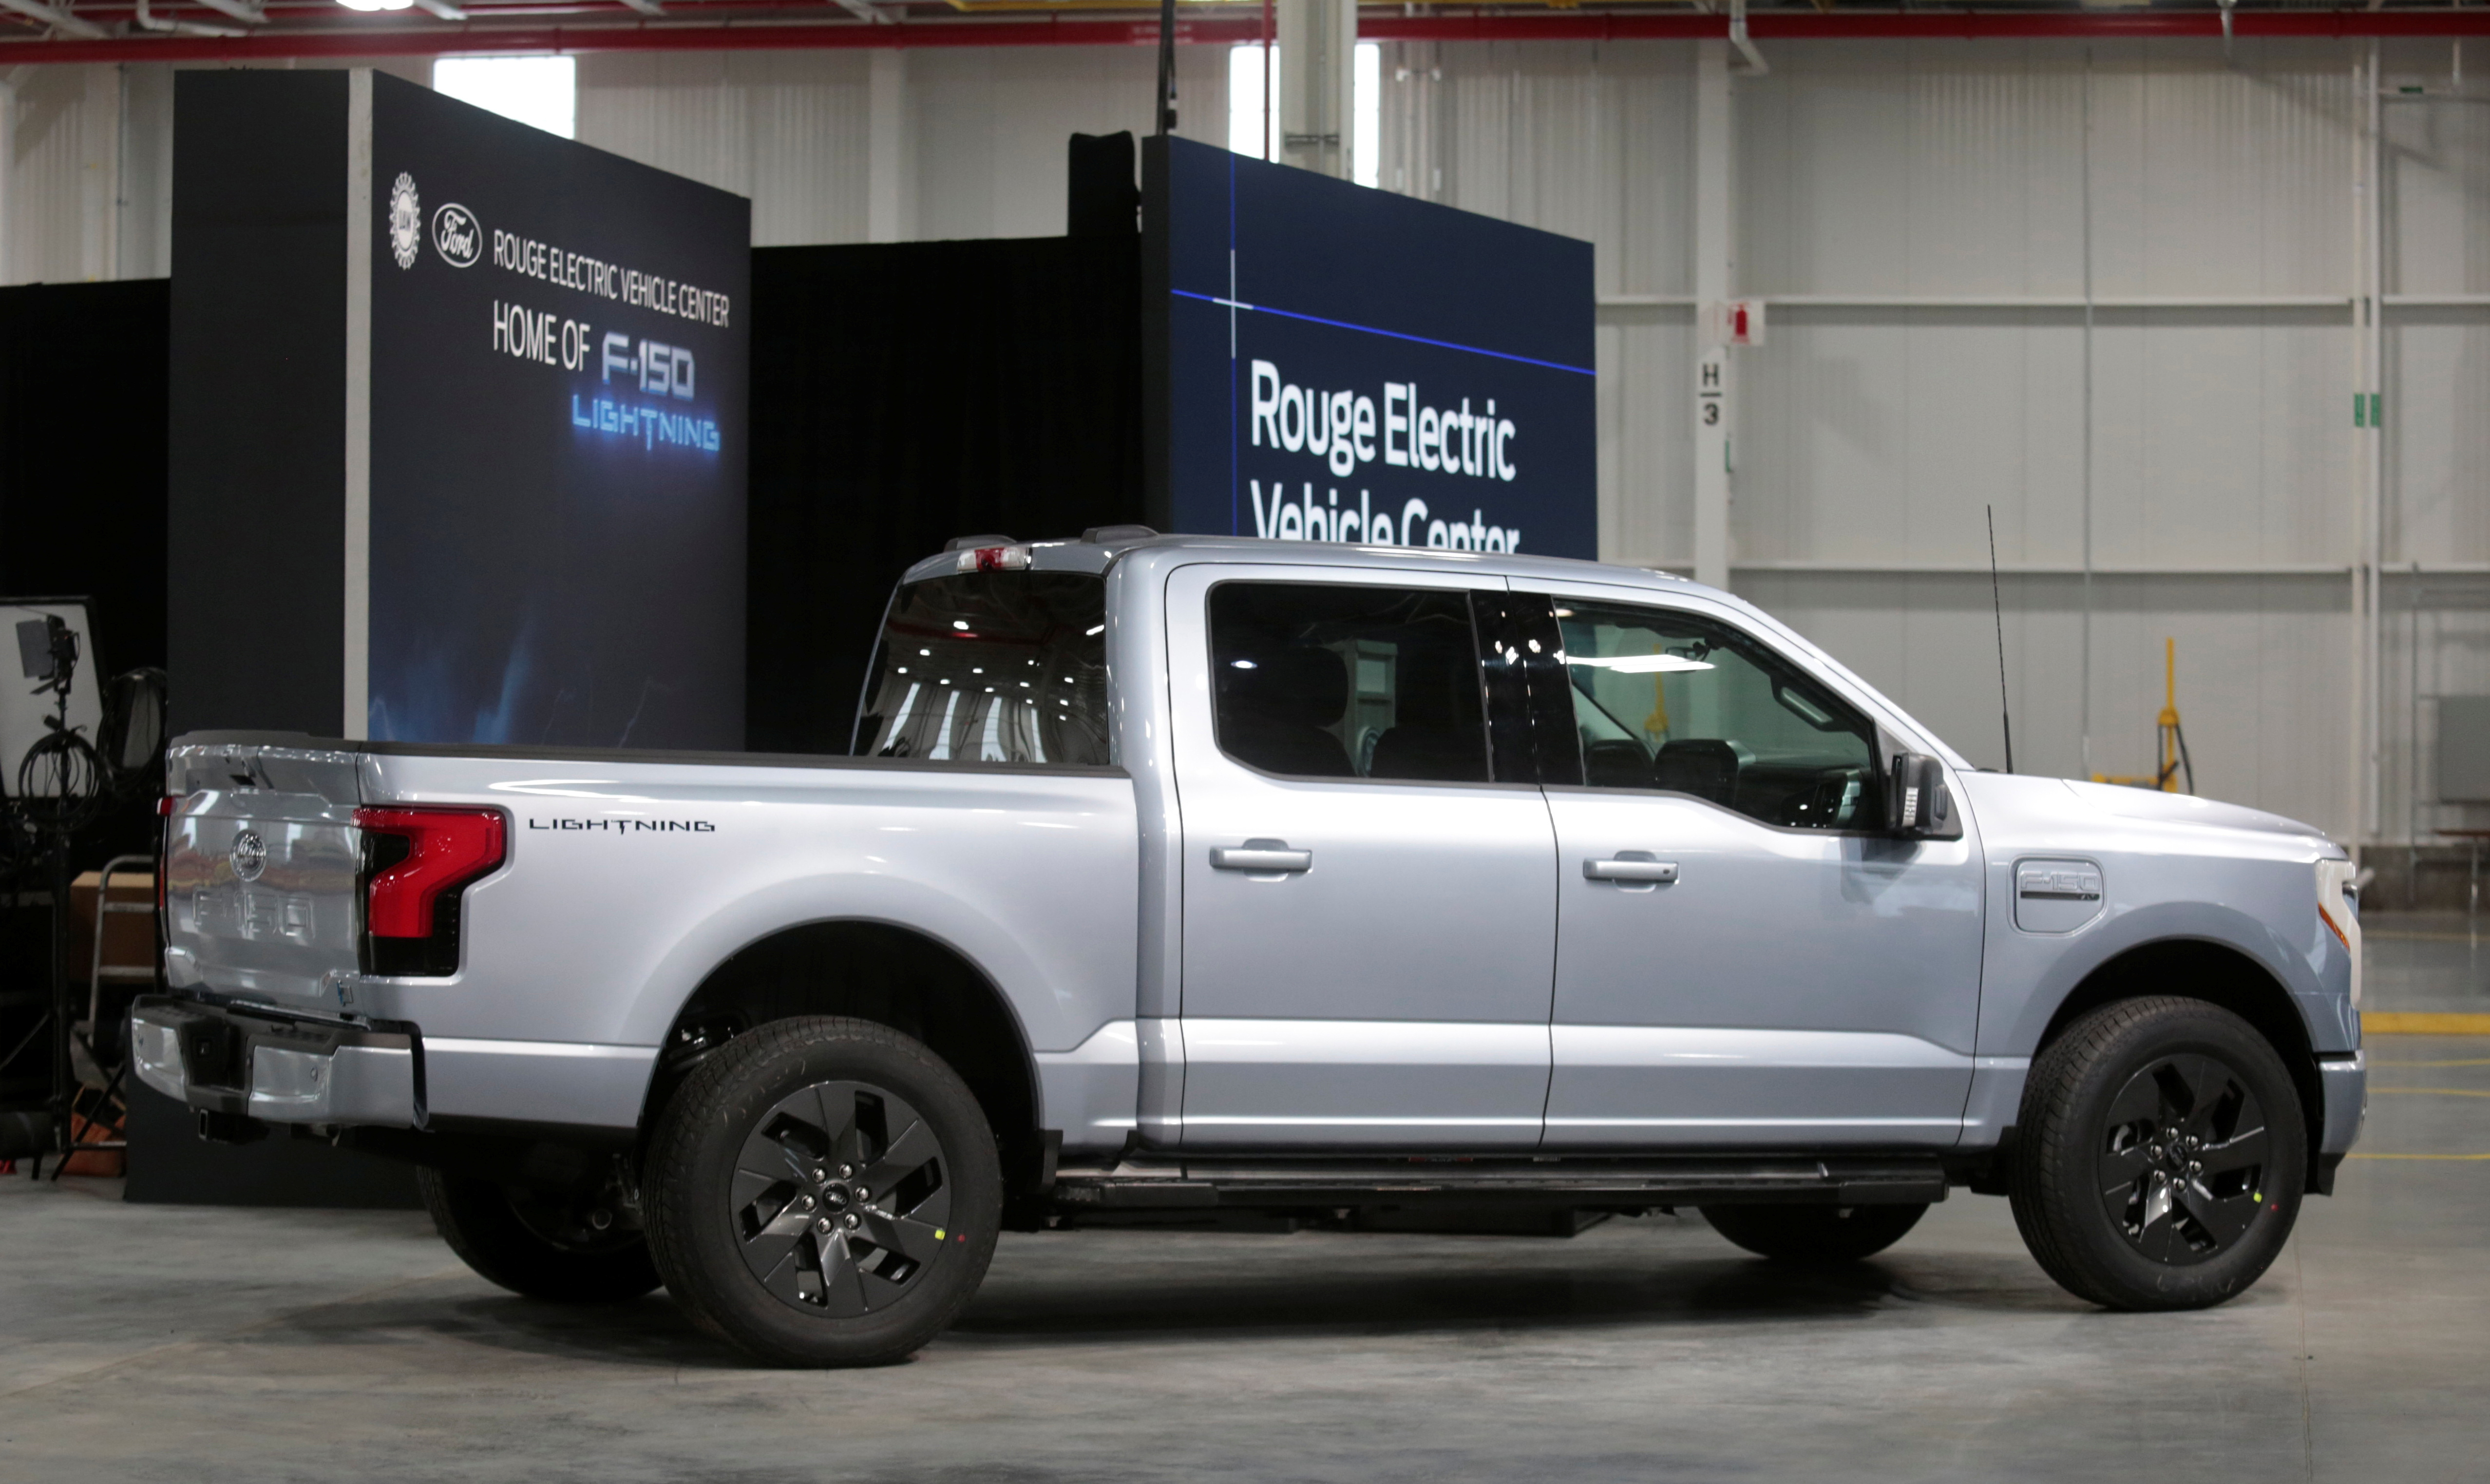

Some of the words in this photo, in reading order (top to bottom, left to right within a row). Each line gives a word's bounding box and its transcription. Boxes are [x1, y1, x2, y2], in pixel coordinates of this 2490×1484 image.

[440, 209, 474, 259] Ford
[494, 229, 547, 280] ROUGE
[550, 247, 617, 300] ELECTRIC
[620, 268, 676, 315] VEHICLE
[679, 284, 730, 328] CENTER
[494, 300, 556, 365] HOME
[562, 319, 590, 372] OF
[602, 331, 695, 400] F-150
[1703, 363, 1719, 385] H
[572, 394, 720, 451] LIGHTNING
[1252, 360, 1376, 476] Rouge
[1384, 382, 1516, 481] Electric
[1704, 402, 1718, 425] 3
[1250, 479, 1394, 544] Vehicle
[530, 818, 715, 835] LIGHTNING
[2020, 871, 2100, 891] F-150
